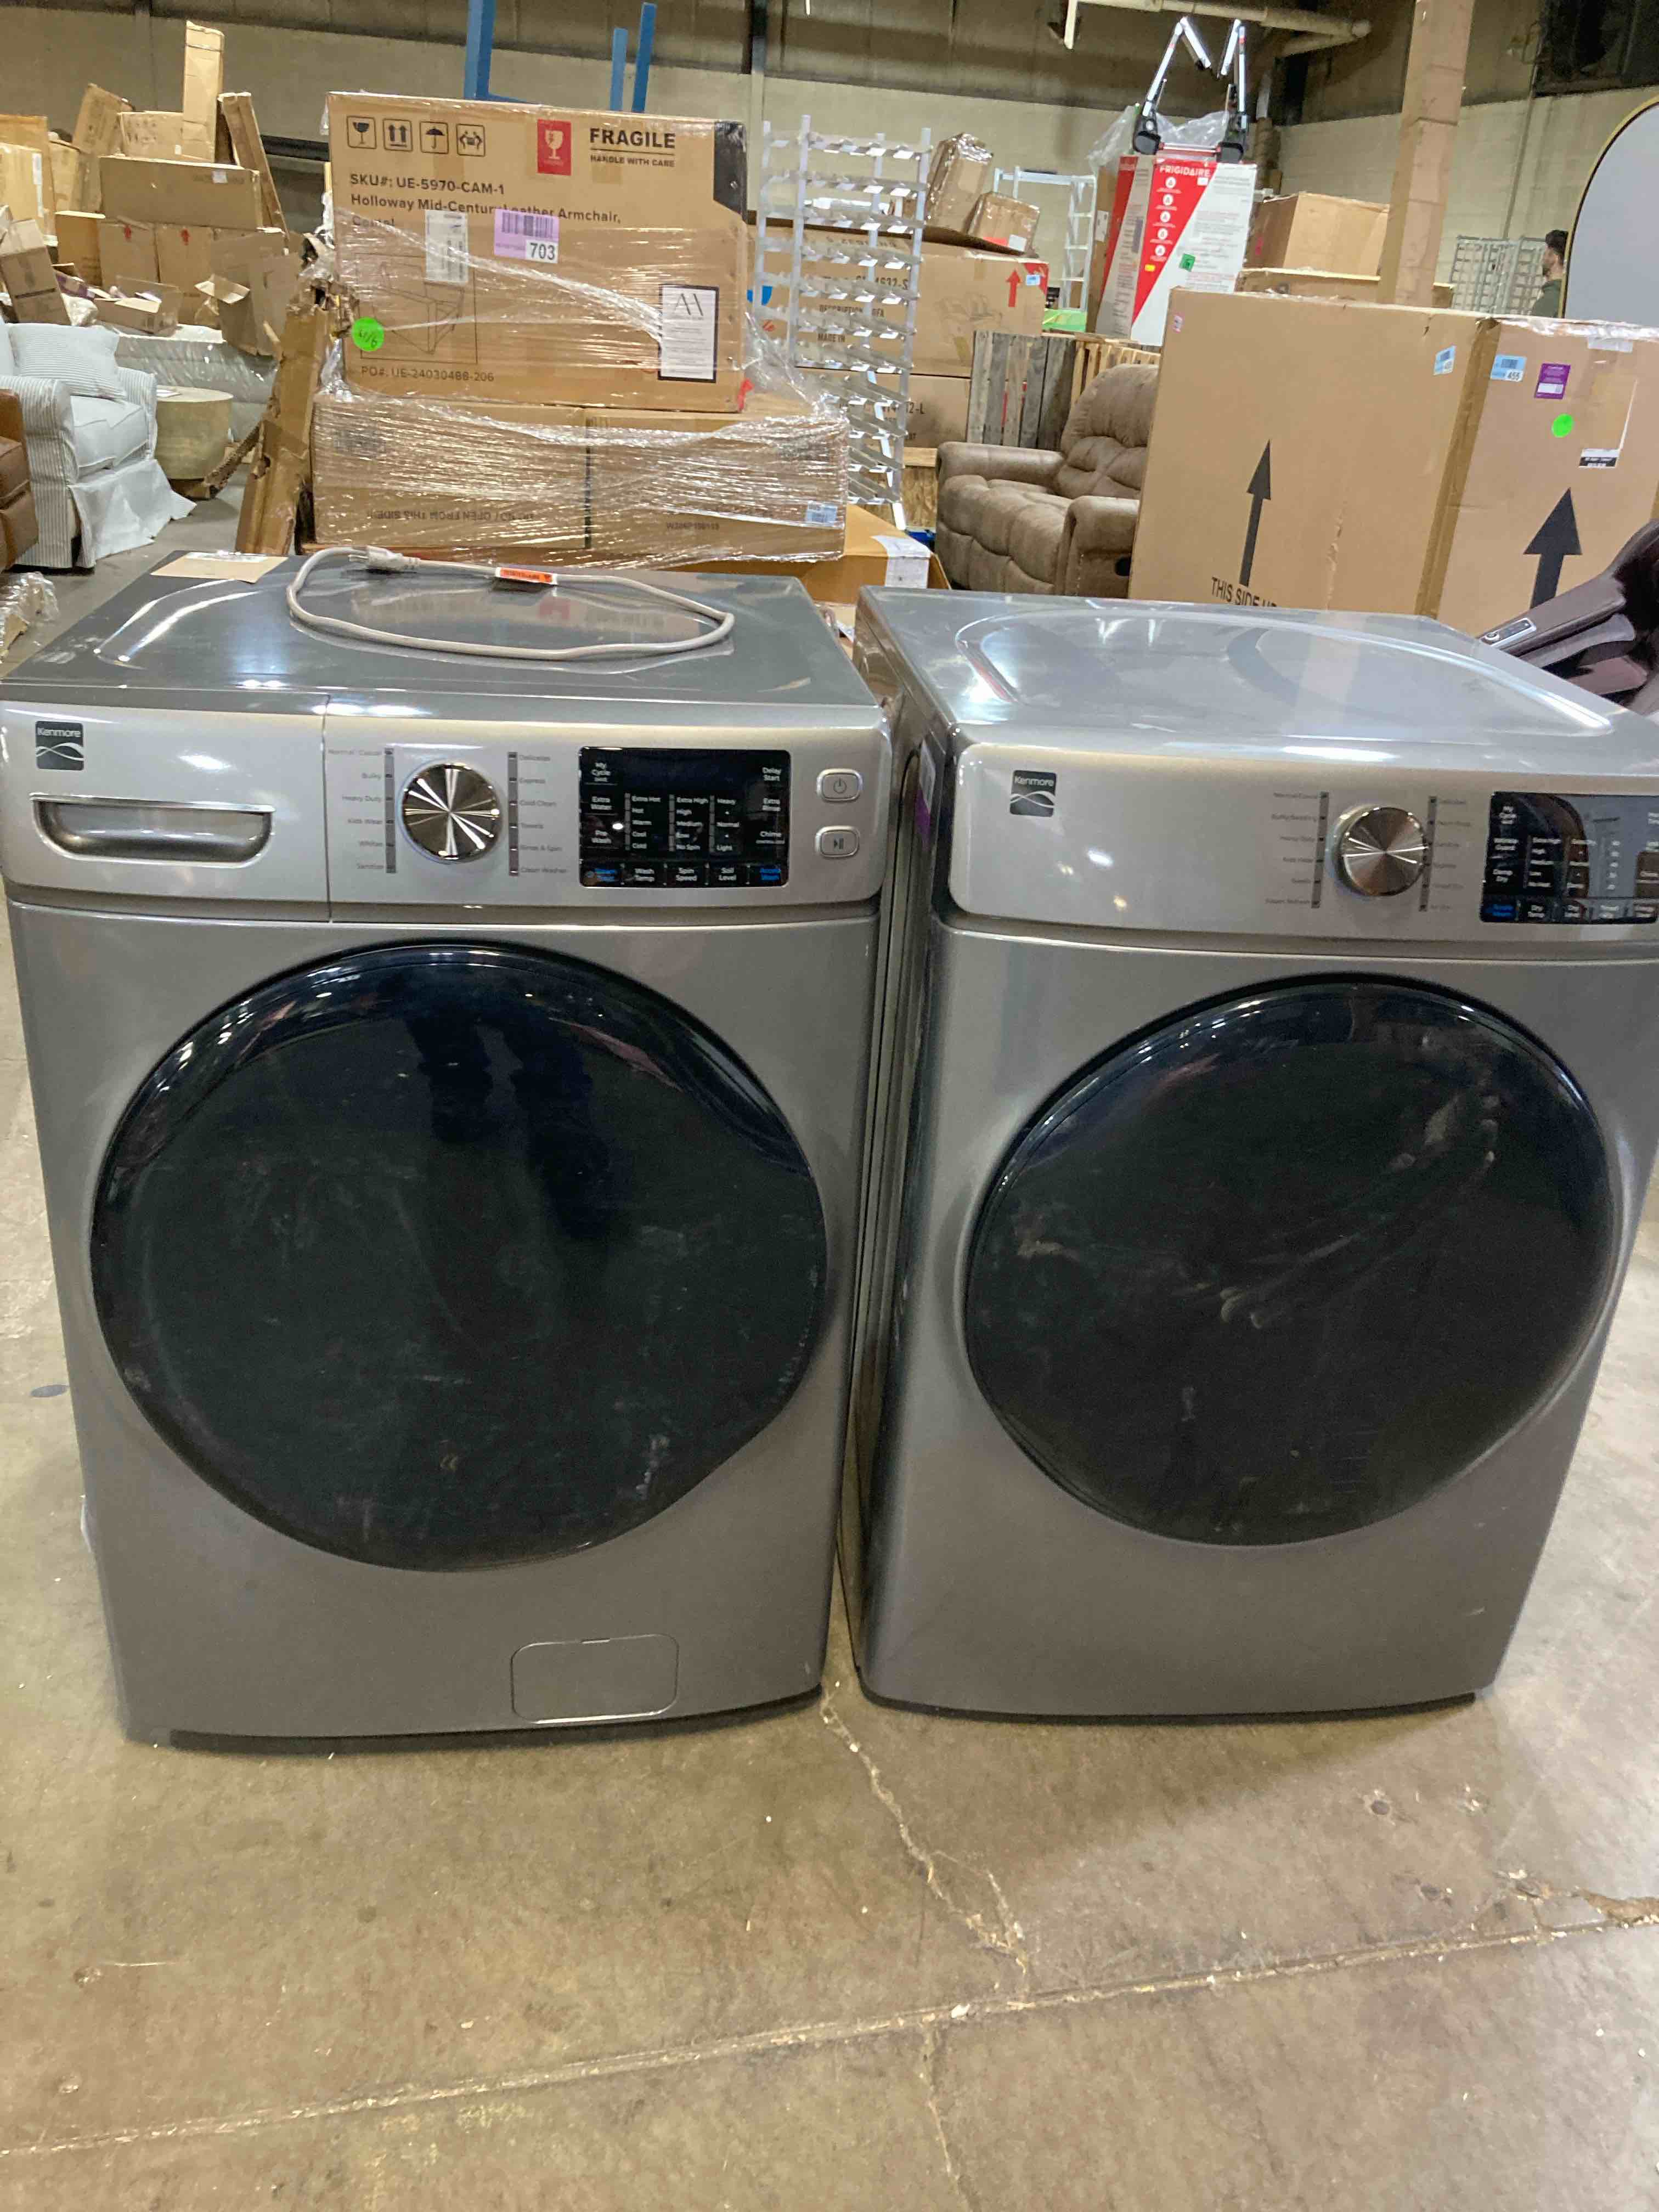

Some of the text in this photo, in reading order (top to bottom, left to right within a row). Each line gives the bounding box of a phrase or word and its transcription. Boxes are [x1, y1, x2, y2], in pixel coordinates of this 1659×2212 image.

[590, 128, 676, 149] FRAGILE
[590, 155, 675, 167] HANDLE WITH CARE
[1159, 165, 1211, 177] FRIGIDAIRE
[350, 173, 505, 195] SKU#: UE-5970-CAM-1
[351, 194, 414, 210] Holloway
[417, 198, 501, 214] Mid-Centur
[557, 208, 621, 224] Armchair,
[530, 242, 556, 261] 703
[1211, 576, 1233, 602] THIS
[762, 767, 782, 775] Delay
